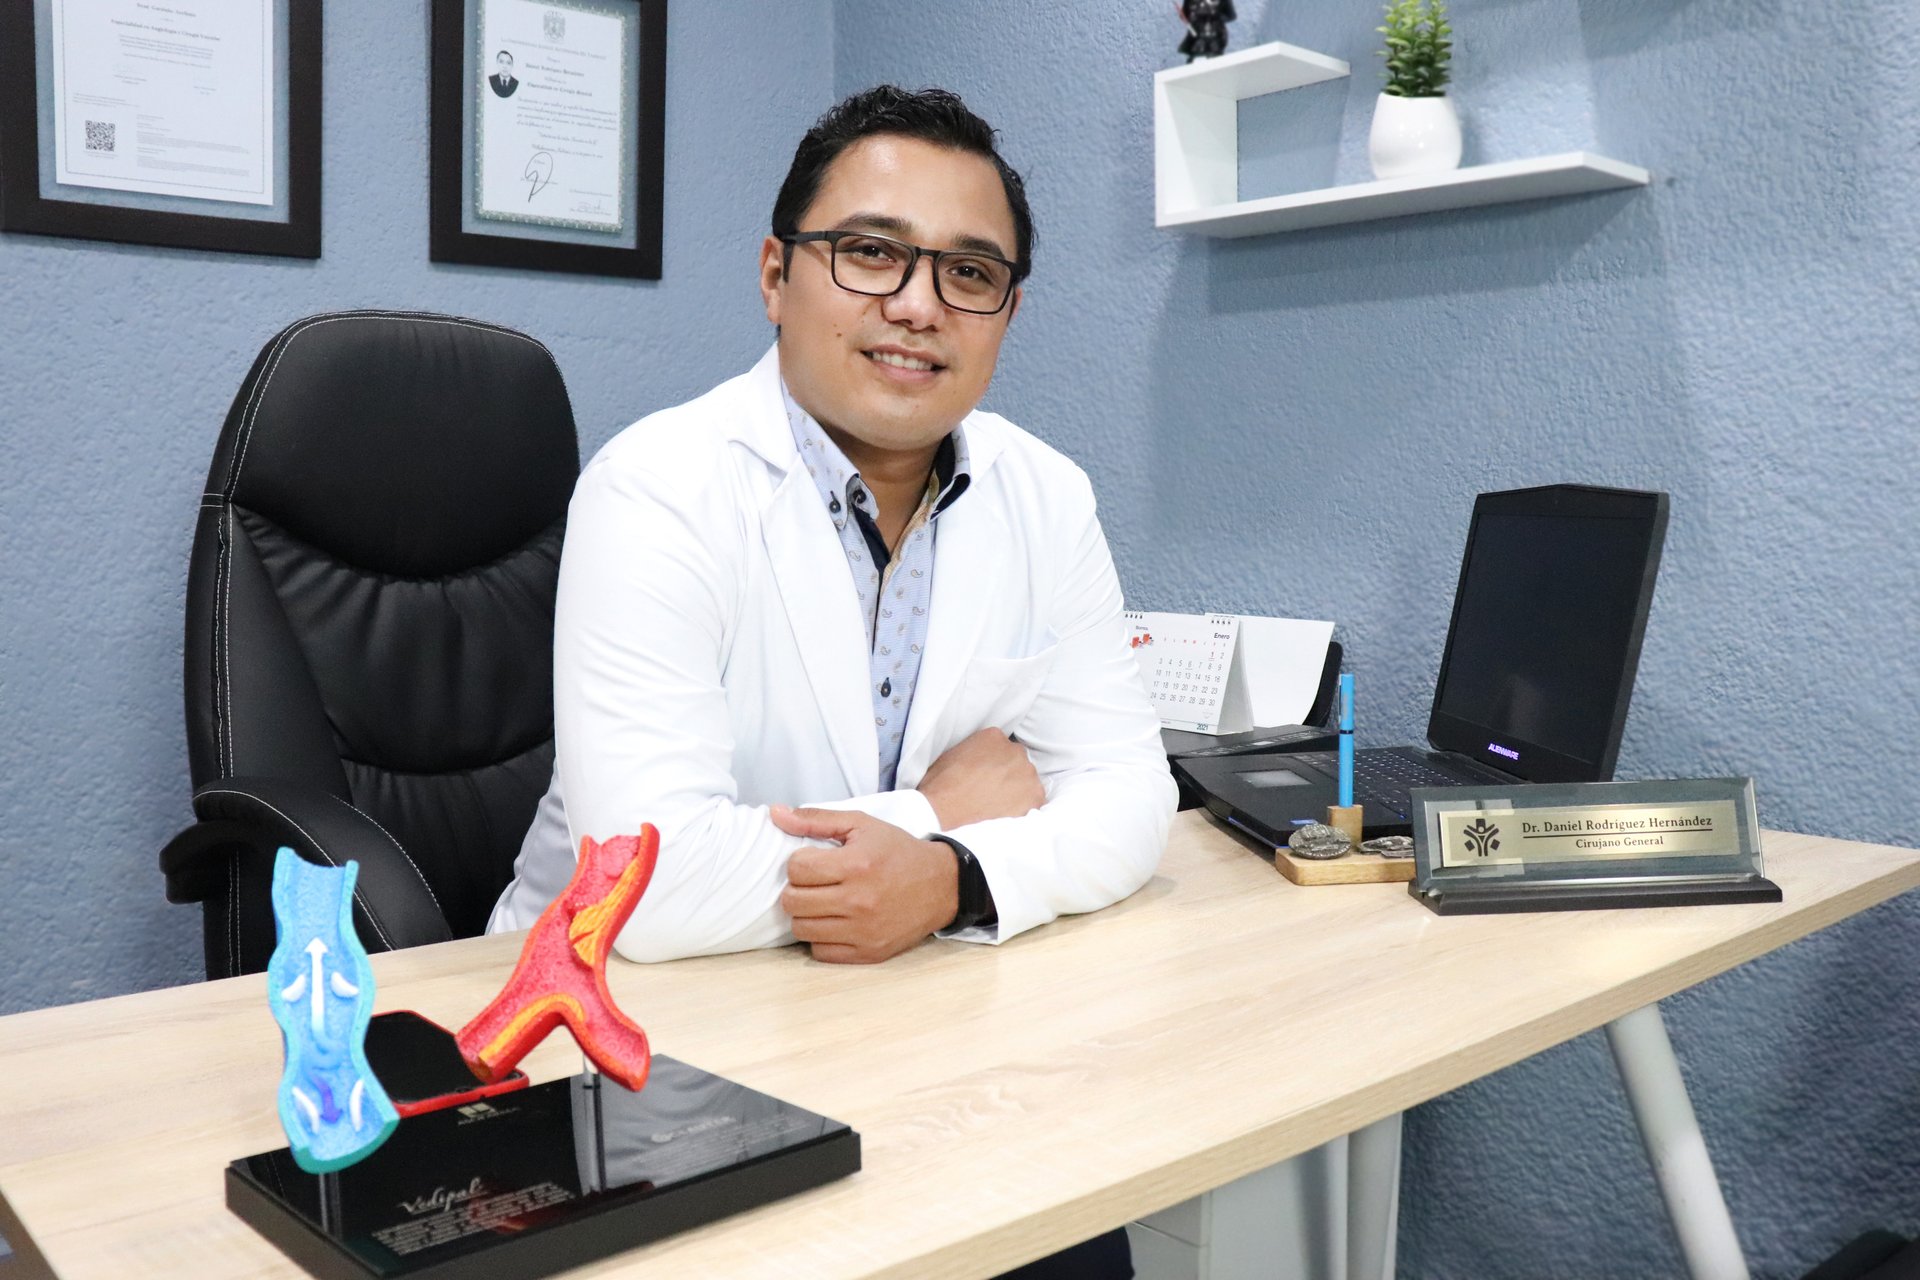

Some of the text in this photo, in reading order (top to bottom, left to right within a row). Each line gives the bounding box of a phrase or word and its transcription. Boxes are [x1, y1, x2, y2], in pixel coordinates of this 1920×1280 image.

[1488, 743, 1520, 760] ALIENWARE
[1522, 822, 1539, 833] Dr.
[1544, 820, 1582, 832] Daniel
[1649, 815, 1713, 827] Hernández
[1576, 836, 1664, 849] Cirujano General
